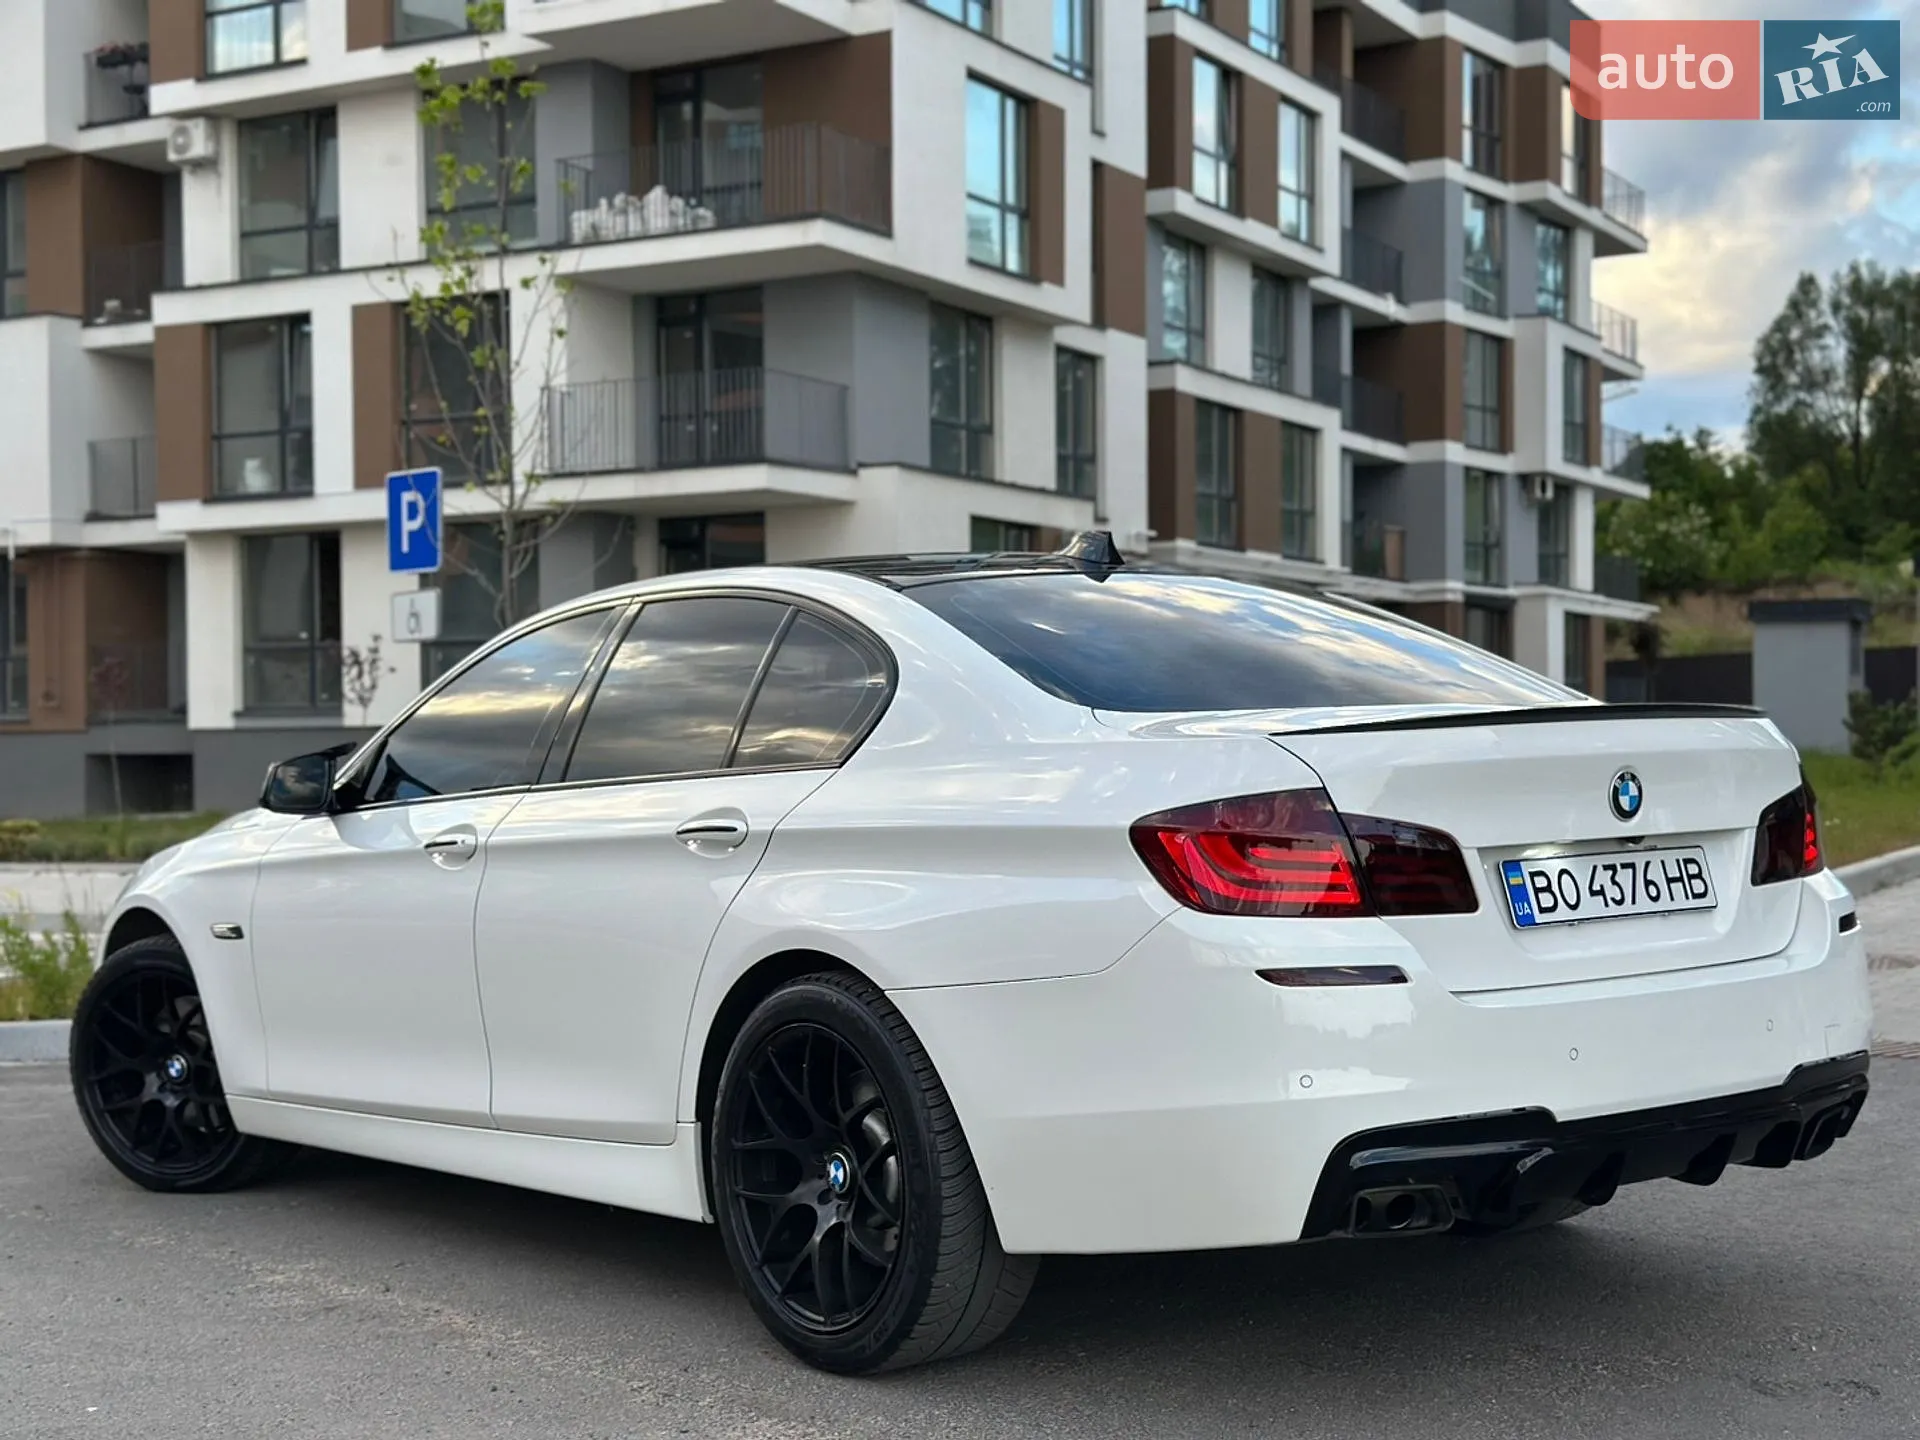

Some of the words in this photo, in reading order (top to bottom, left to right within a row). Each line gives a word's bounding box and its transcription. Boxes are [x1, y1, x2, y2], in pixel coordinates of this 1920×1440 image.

[401, 490, 425, 554] P
[1515, 903, 1532, 916] UA
[1527, 868, 1581, 915] BO
[1588, 860, 1661, 908] 4376
[1661, 857, 1709, 902] HB
